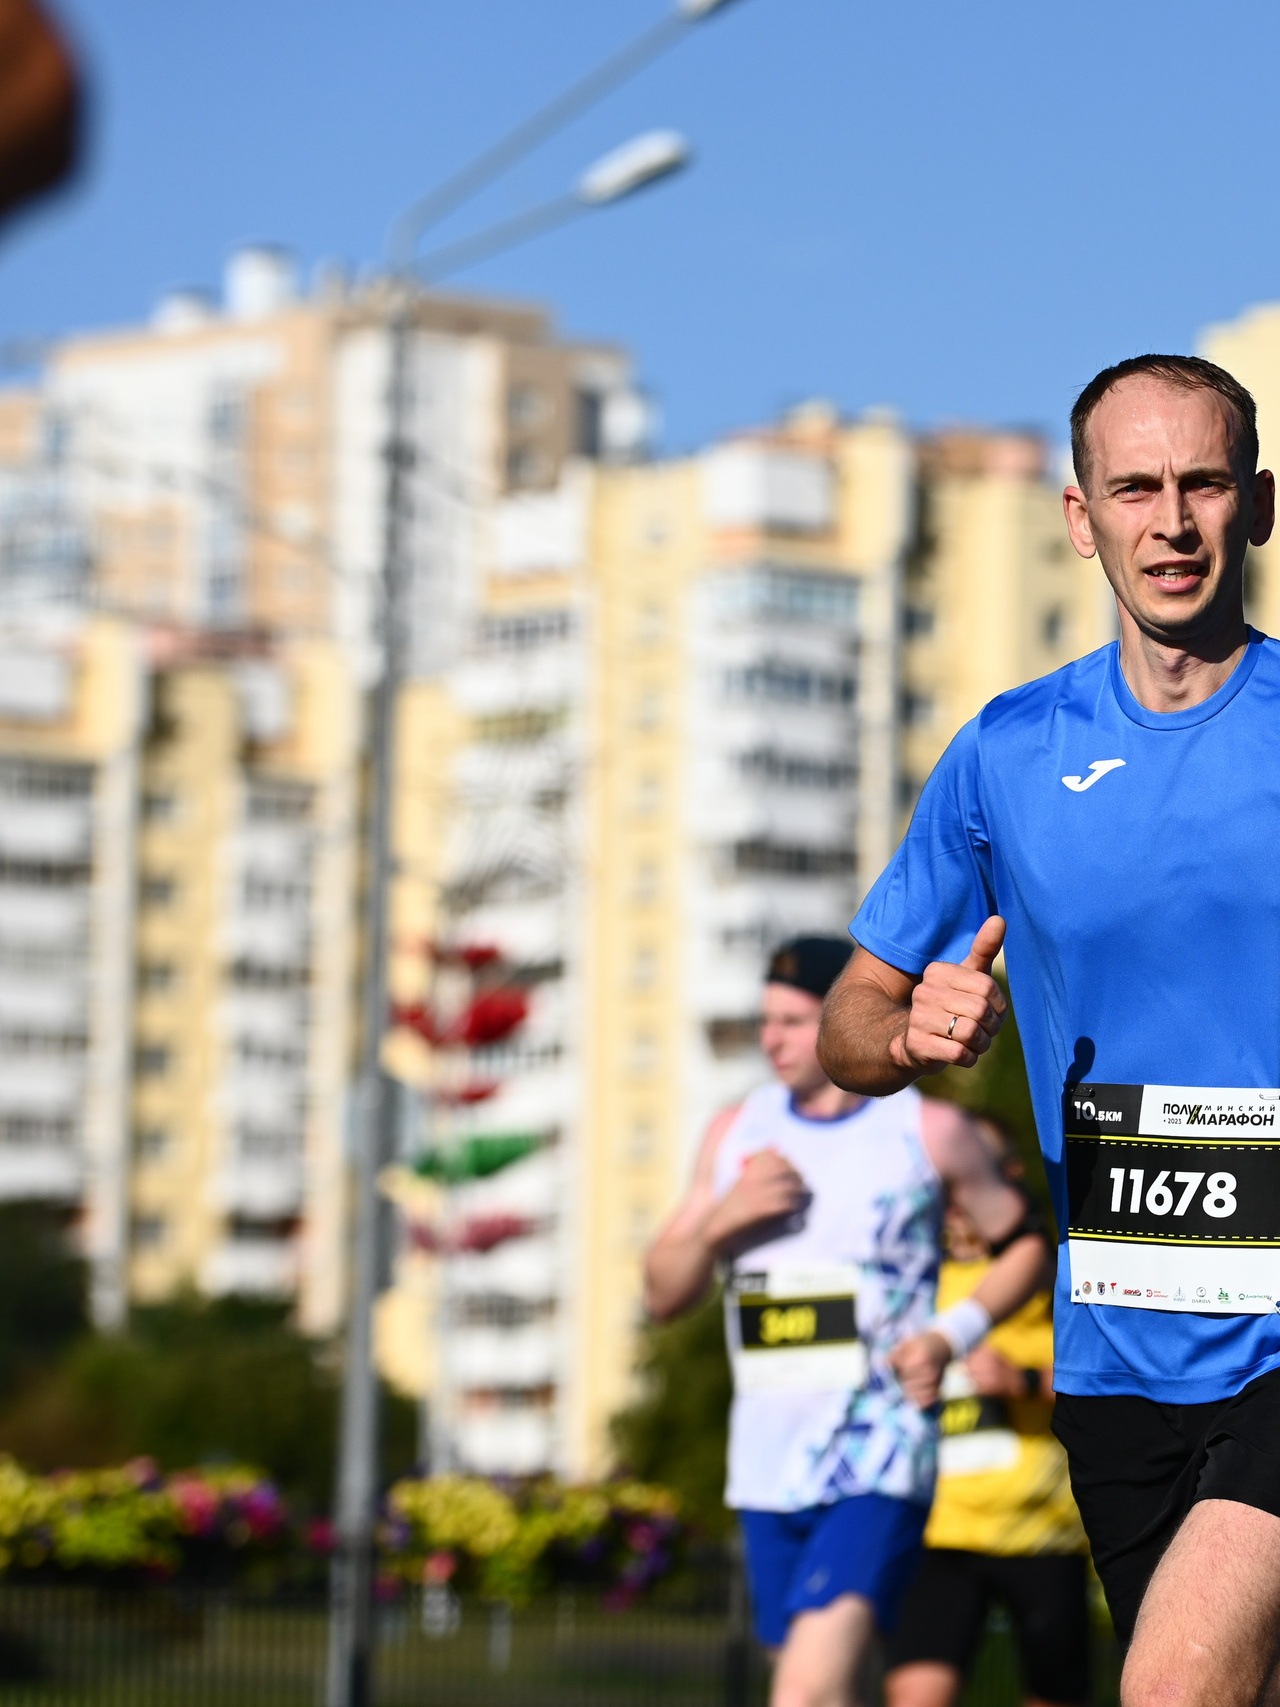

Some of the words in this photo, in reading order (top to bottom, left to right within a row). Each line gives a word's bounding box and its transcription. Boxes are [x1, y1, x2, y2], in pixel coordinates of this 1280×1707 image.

[1204, 1104, 1276, 1112] МИНСКИЙ
[1188, 1113, 1275, 1126] МАРАФОН
[1110, 1167, 1238, 1218] 11678
